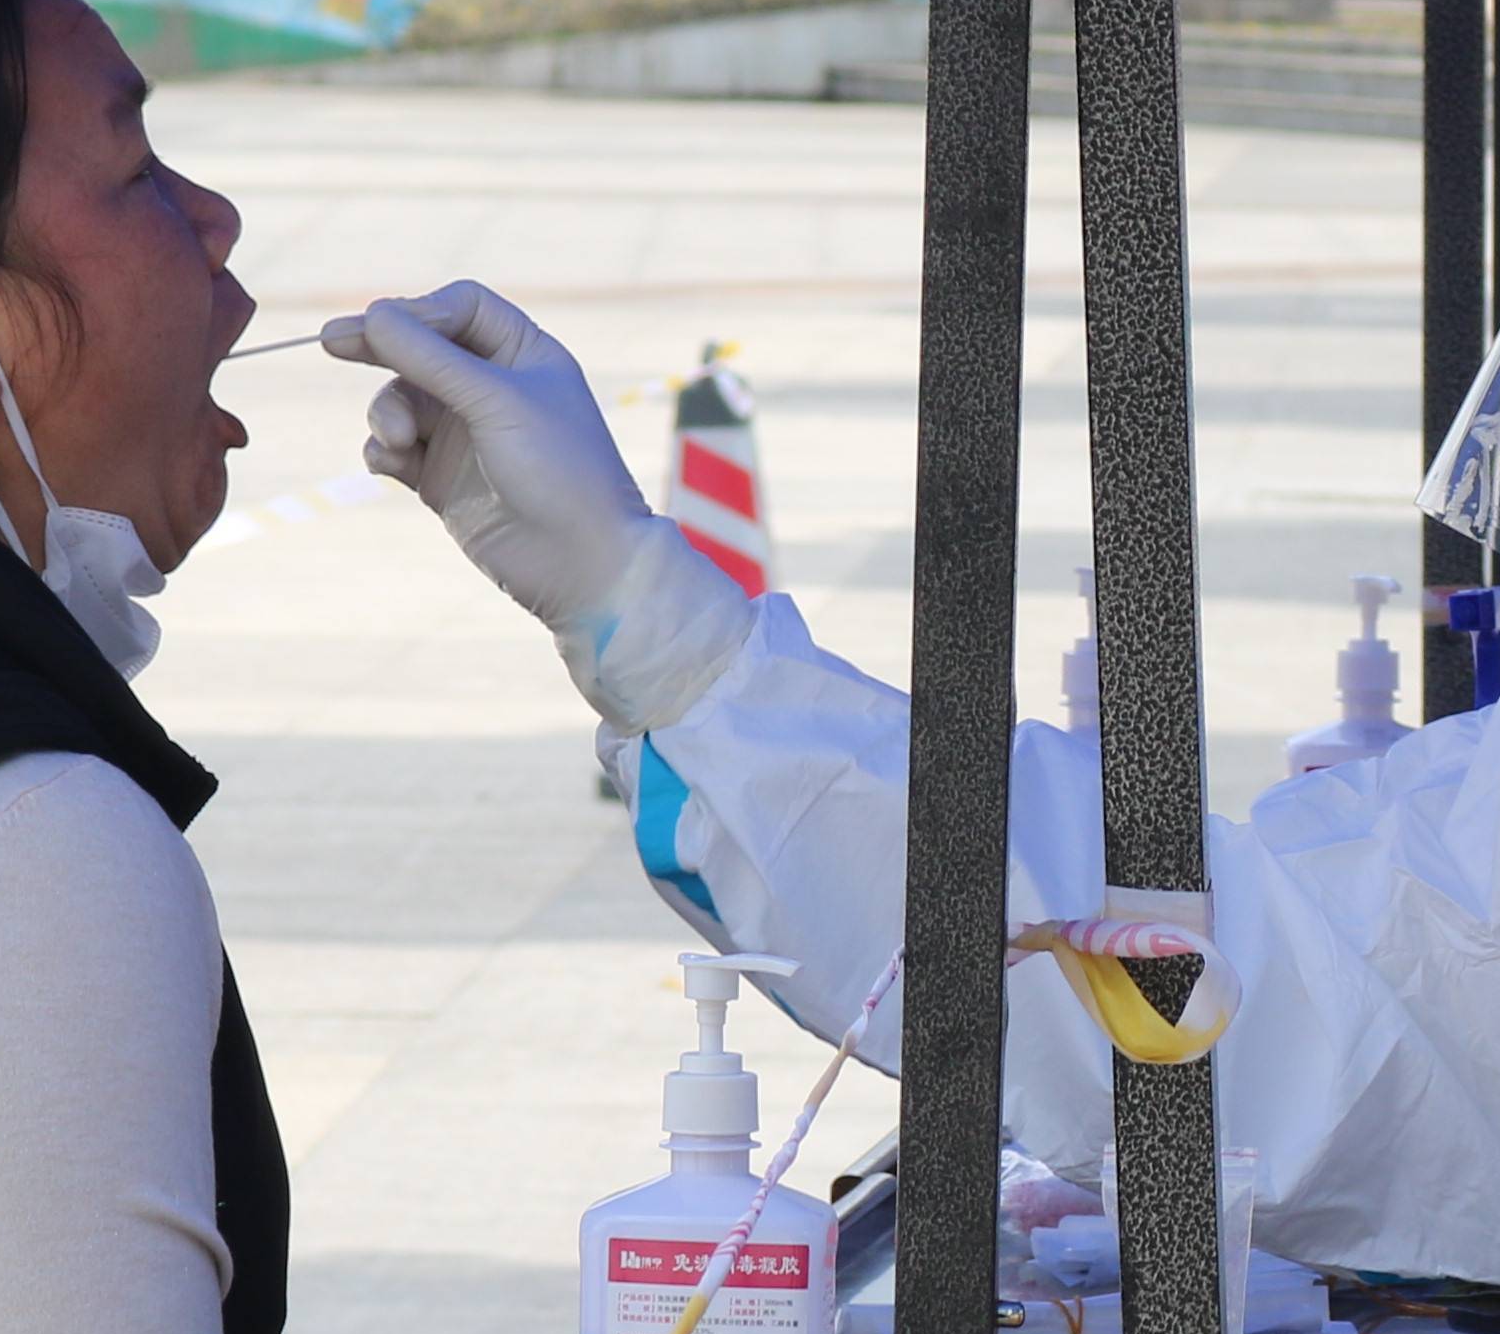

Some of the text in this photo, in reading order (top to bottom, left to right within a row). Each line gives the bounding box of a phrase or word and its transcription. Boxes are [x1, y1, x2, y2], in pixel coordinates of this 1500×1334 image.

[672, 1252, 802, 1276] 免洗毒凝胶
